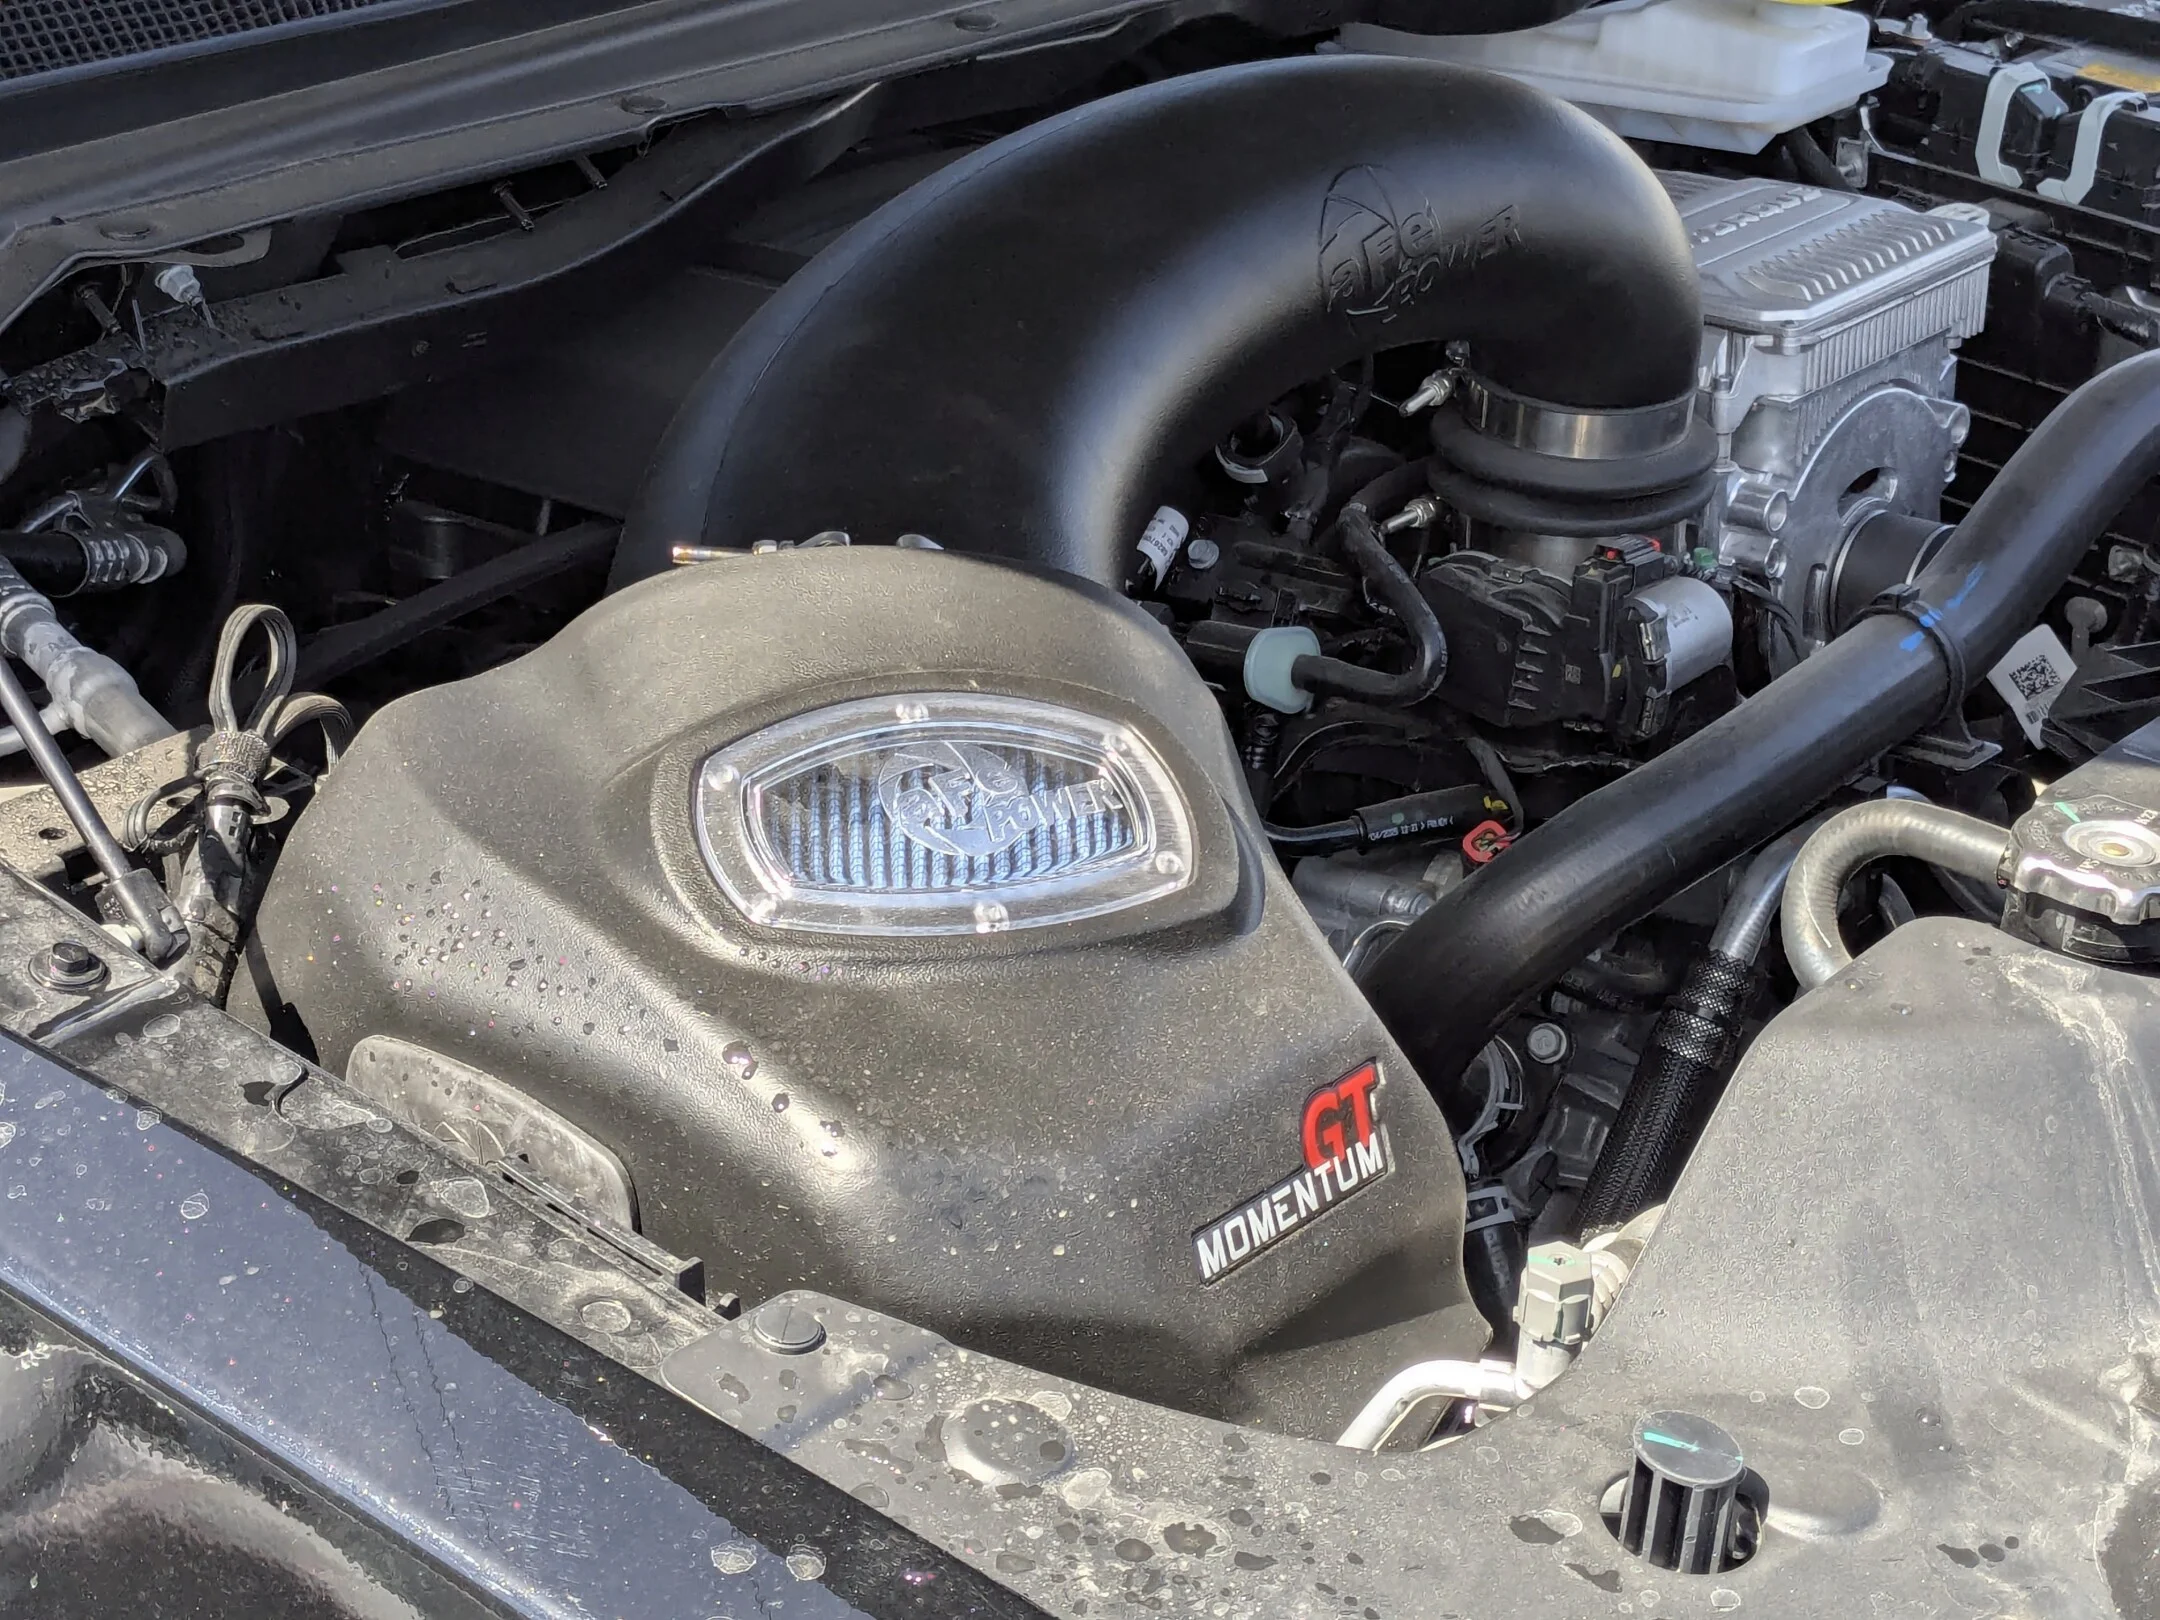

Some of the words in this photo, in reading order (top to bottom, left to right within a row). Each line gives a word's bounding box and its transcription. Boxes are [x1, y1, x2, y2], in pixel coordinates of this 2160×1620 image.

[983, 778, 1124, 843] POWER
[1303, 1063, 1377, 1171] GT
[1196, 1132, 1385, 1279] MOMENTUM
